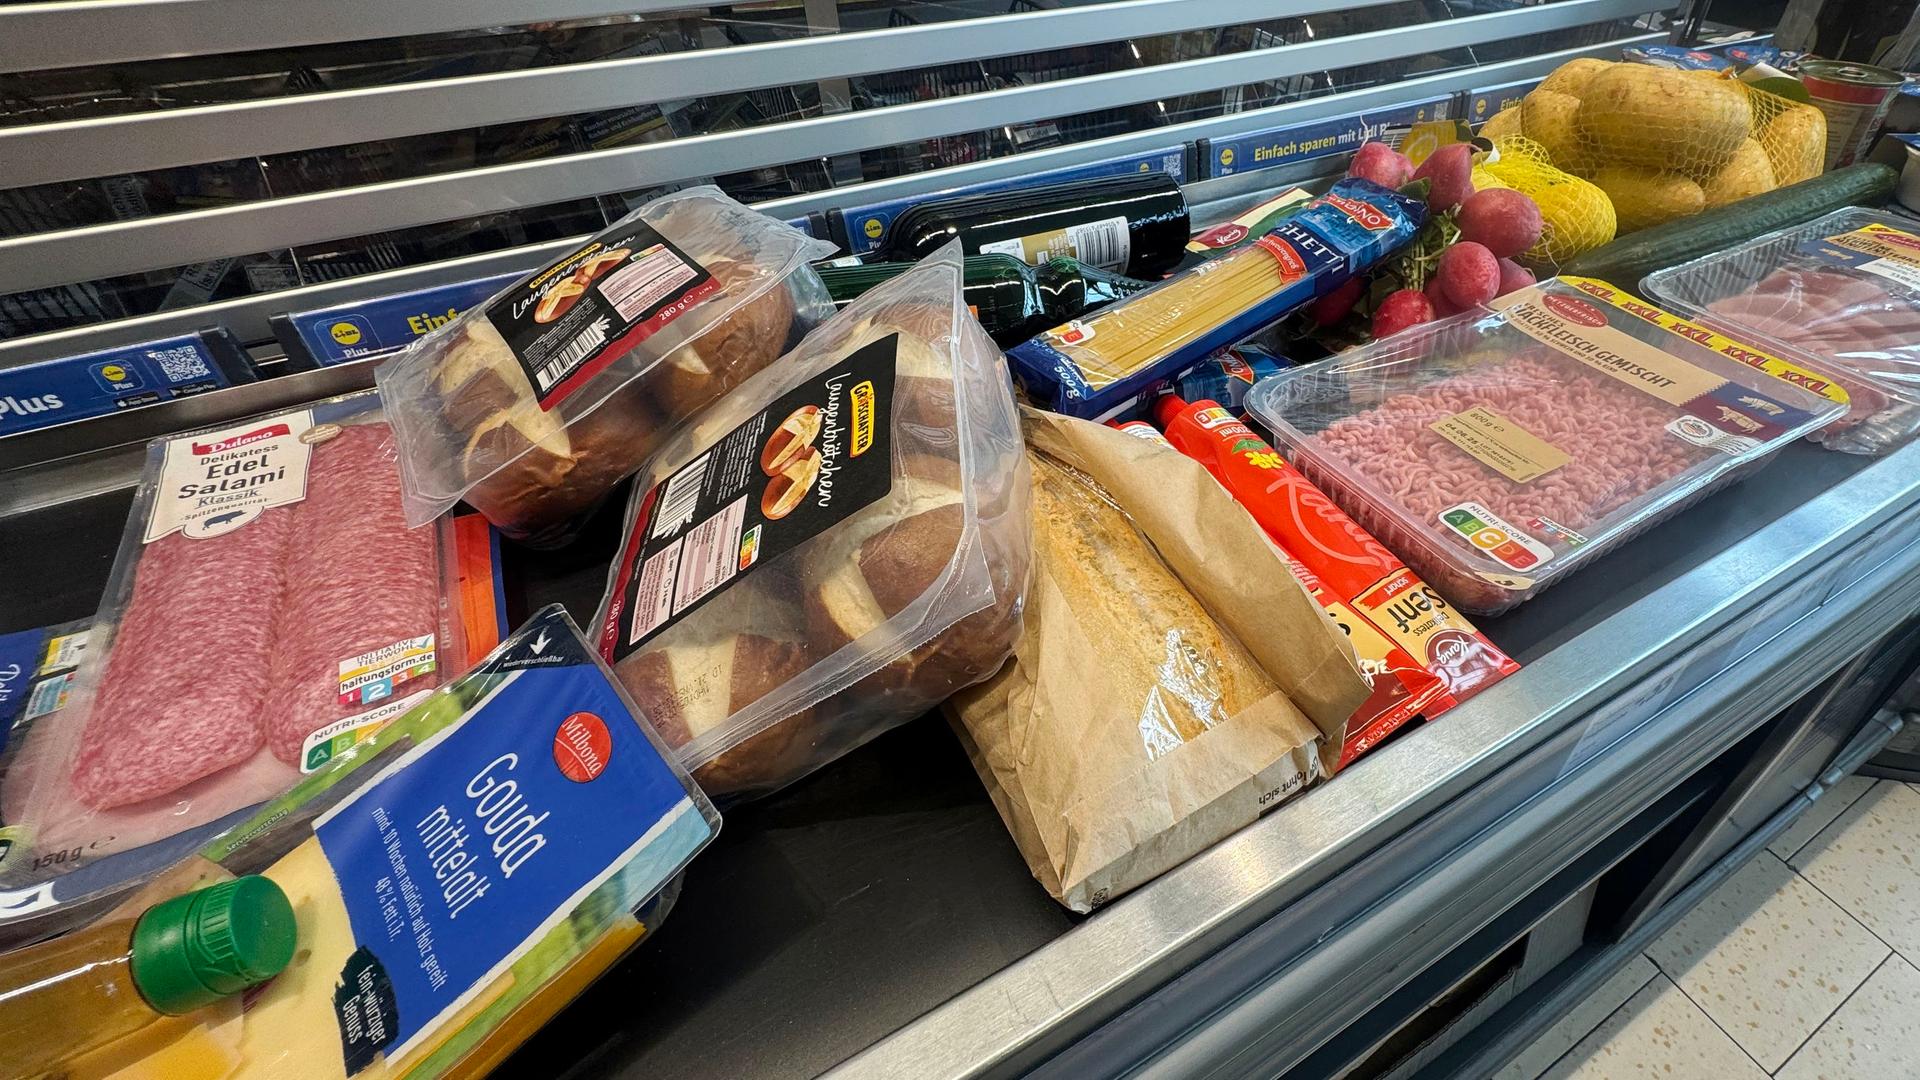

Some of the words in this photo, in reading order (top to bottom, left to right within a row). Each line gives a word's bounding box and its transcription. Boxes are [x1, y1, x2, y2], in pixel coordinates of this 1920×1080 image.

[1254, 142, 1297, 162] Einfach
[1299, 136, 1336, 155] sparen
[1338, 131, 1356, 144] mit
[1216, 229, 1241, 245] Kania
[658, 307, 676, 321] 280
[1622, 301, 1661, 325] XXL
[1671, 321, 1713, 348] XXL
[343, 347, 371, 358] Plus
[1720, 344, 1770, 373] XXL
[1595, 350, 1676, 388] GEMISCHT
[113, 382, 134, 391] Plus
[1777, 368, 1831, 399] XXL
[200, 444, 279, 466] Delikatess
[210, 431, 273, 453] Dulano
[206, 454, 269, 480] Edel
[178, 466, 286, 500] Salami
[198, 490, 262, 508] Klassik
[1463, 523, 1477, 532] B
[1479, 531, 1501, 545] C
[1469, 505, 1533, 545] NUTRI-SCORE
[1384, 576, 1409, 596] scharf
[1387, 586, 1446, 634] Senf
[1412, 611, 1450, 637] Delikatess
[357, 639, 416, 663] INITIATIVE
[359, 644, 416, 667] TIERWOHL
[1435, 635, 1470, 665] Kania
[342, 653, 433, 692] haltungsform.de
[368, 684, 386, 700] 2
[399, 673, 408, 682] 3
[418, 665, 431, 673] 4
[314, 703, 405, 741] NUTRI-SCORE
[311, 749, 328, 764] A
[337, 738, 350, 751] B
[562, 715, 602, 774] Milbona
[1281, 770, 1308, 793] lohnt
[1258, 787, 1280, 806] sich
[371, 807, 394, 835] mind.
[466, 753, 550, 879] Gouda
[383, 828, 397, 845] 10
[387, 836, 408, 879] Wochen
[416, 804, 492, 919] mittelalt
[375, 876, 391, 893] 48
[399, 876, 425, 919] natürlich
[412, 916, 431, 935] auf
[416, 927, 435, 958] Holz
[420, 953, 449, 993] gereift
[357, 963, 388, 1046] fein-würziger
[343, 994, 363, 1045] Genuss
